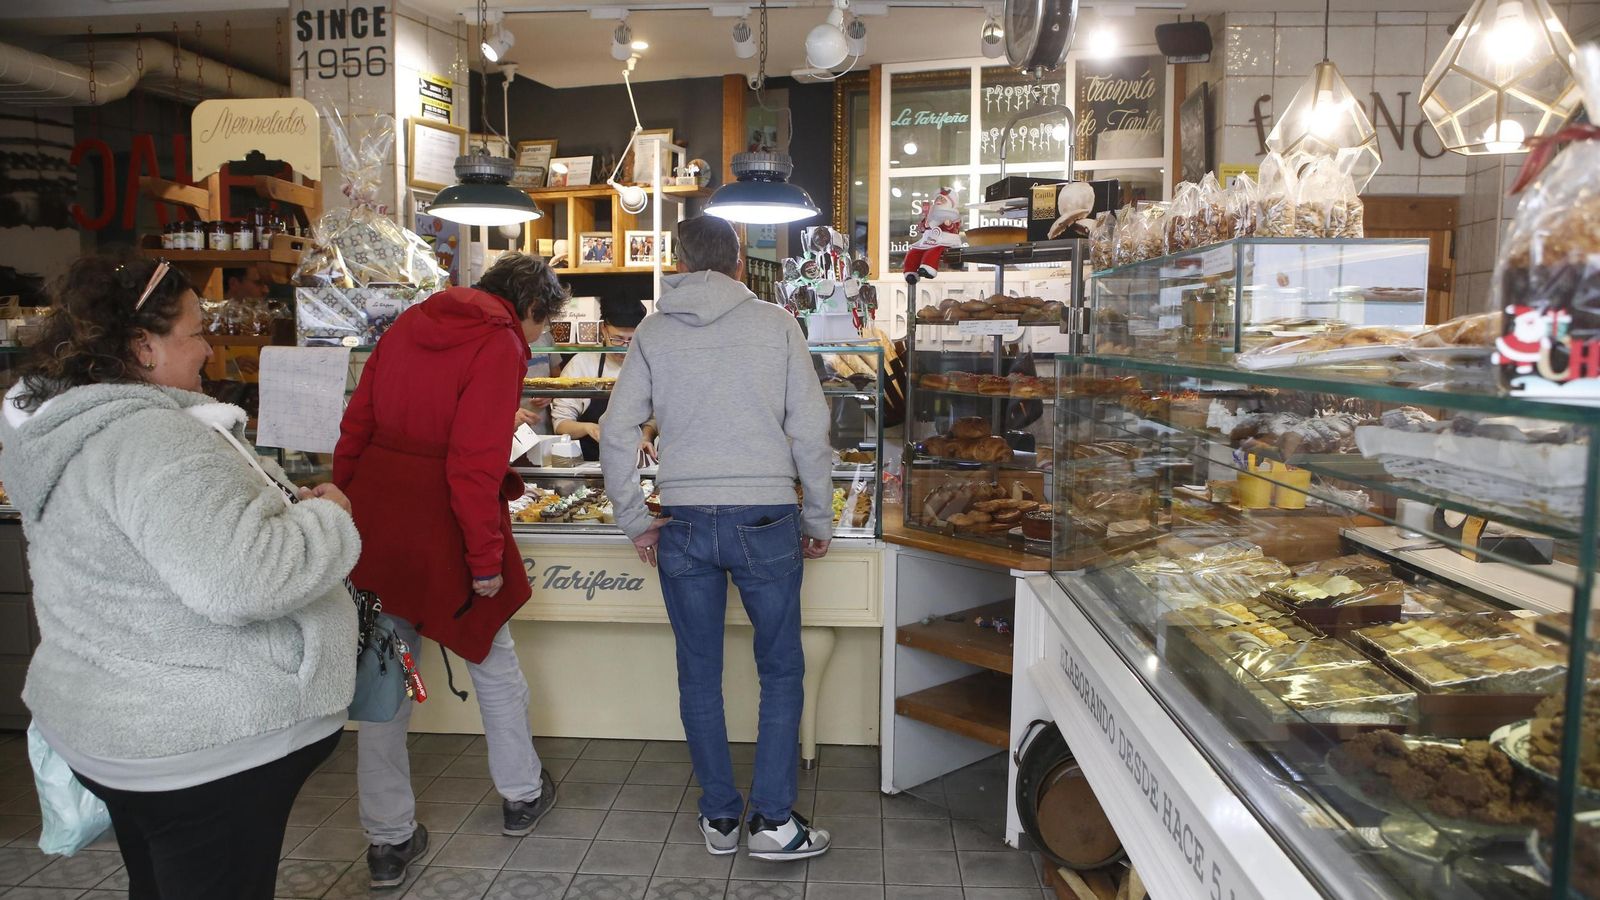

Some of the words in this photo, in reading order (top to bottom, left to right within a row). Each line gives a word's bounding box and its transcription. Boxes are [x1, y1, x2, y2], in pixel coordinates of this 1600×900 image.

[296, 6, 386, 42] SINCE
[297, 45, 386, 80] 1956
[891, 108, 912, 126] La
[914, 110, 969, 130] Tarifeña
[1075, 109, 1097, 137] de
[542, 565, 645, 601] Tarifeña
[1059, 643, 1115, 745] ELABORANDO
[1118, 728, 1159, 814] DESDE
[1162, 791, 1205, 885] HACE
